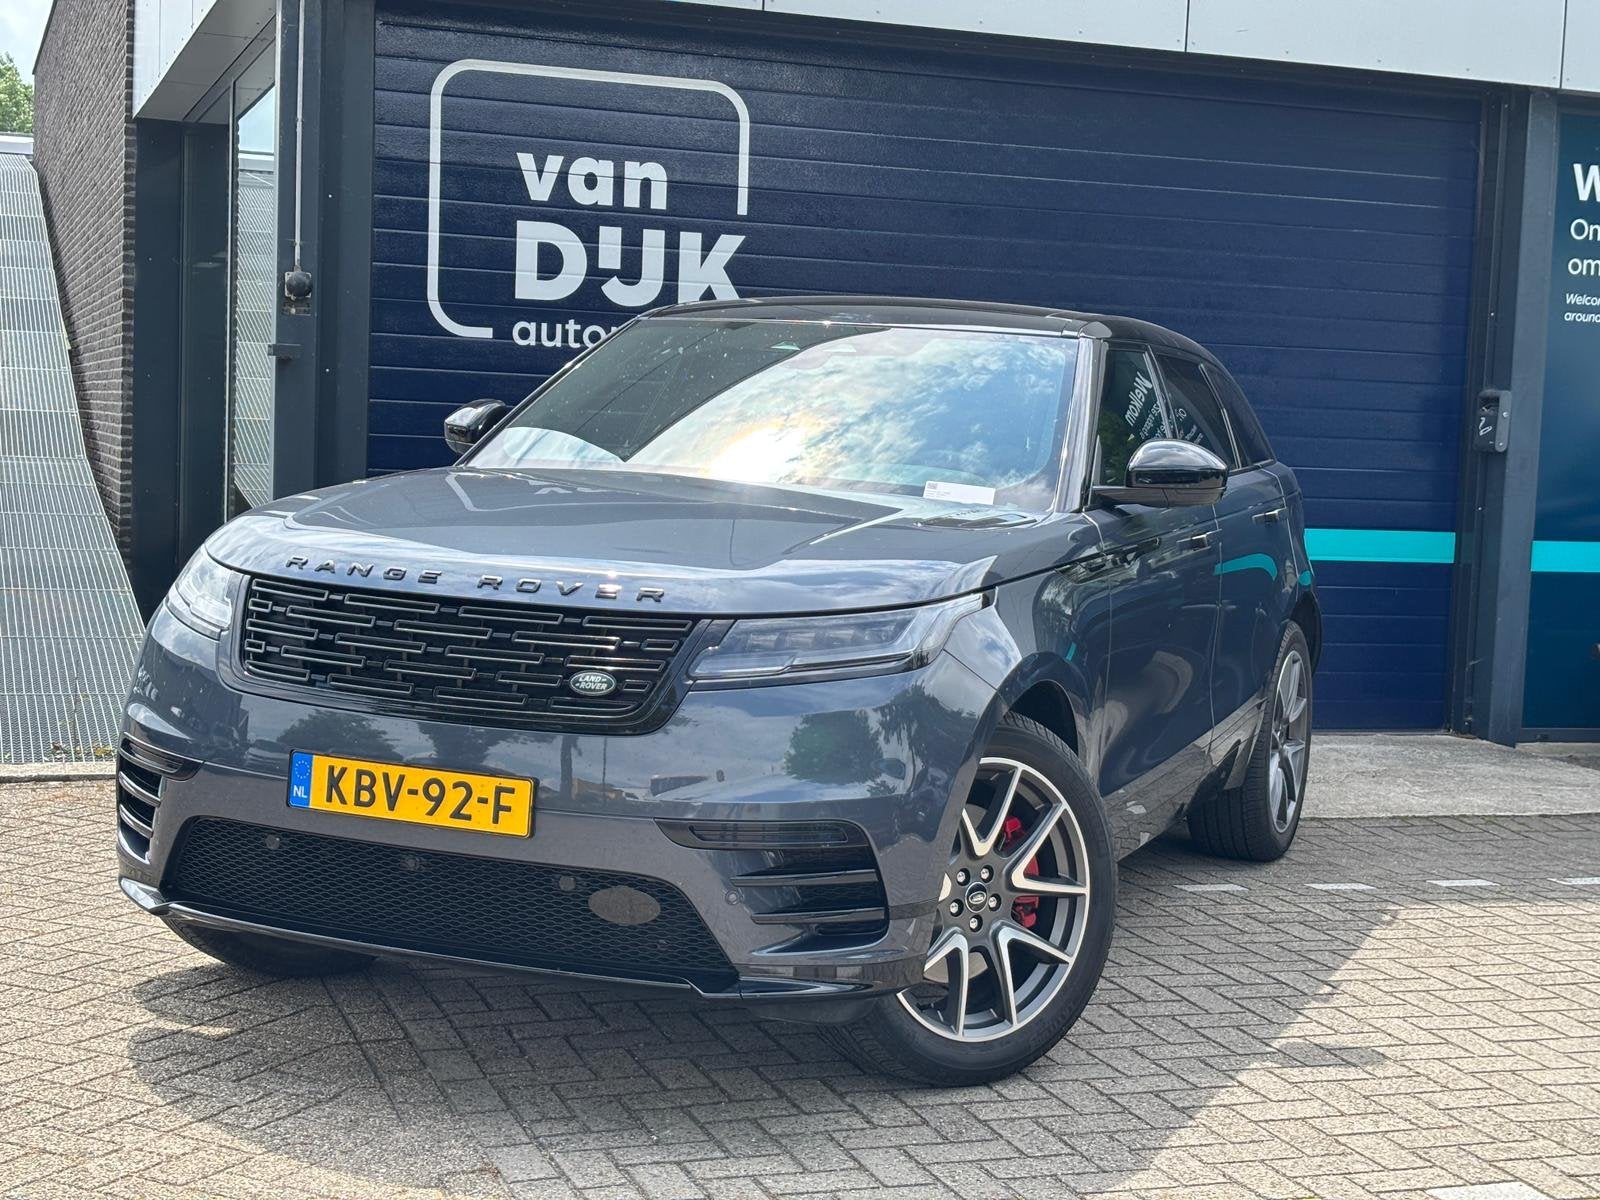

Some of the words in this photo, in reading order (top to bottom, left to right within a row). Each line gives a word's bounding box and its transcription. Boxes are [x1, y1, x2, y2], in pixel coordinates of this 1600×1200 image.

[516, 152, 667, 210] van
[512, 319, 618, 348] auto
[285, 555, 442, 584] RANGE
[477, 574, 664, 603] ROVER
[293, 784, 307, 799] NL
[325, 764, 515, 825] KBV-92-F
